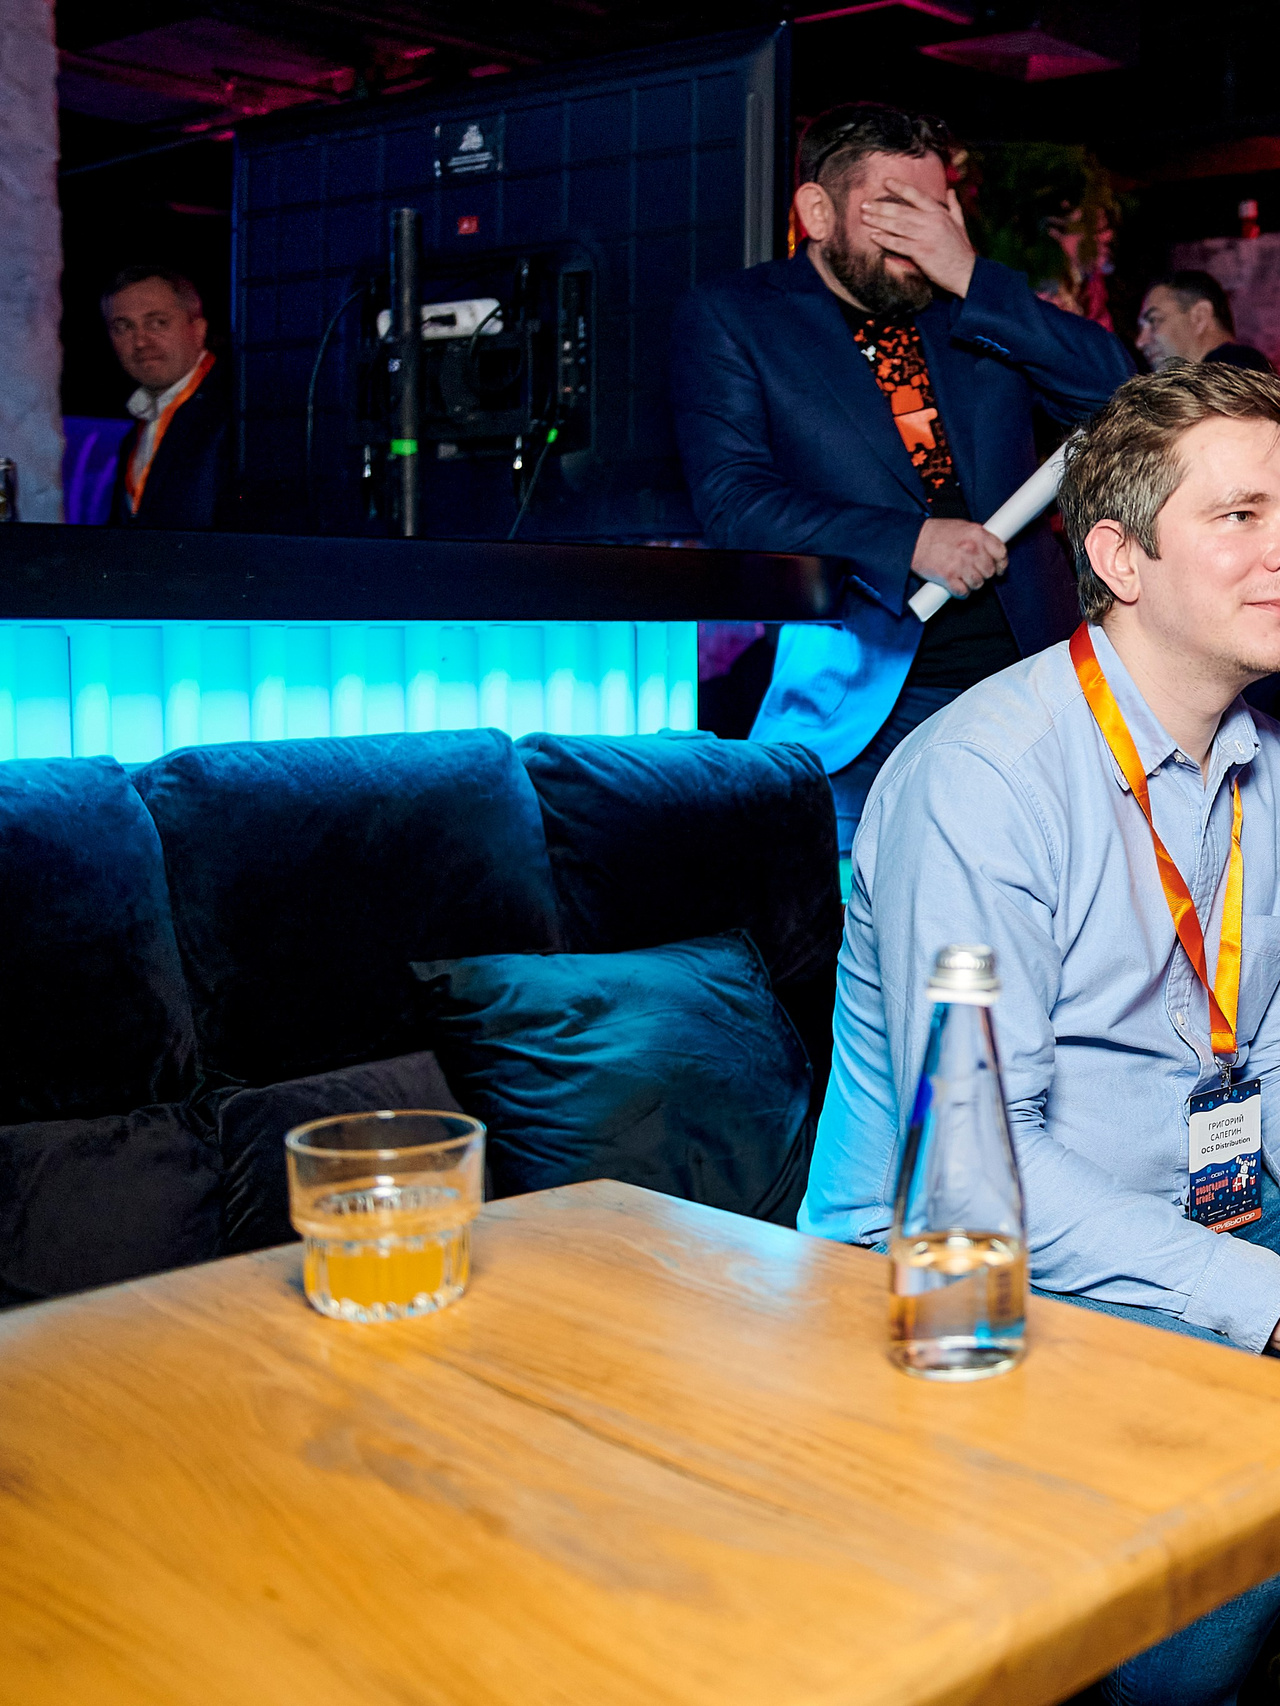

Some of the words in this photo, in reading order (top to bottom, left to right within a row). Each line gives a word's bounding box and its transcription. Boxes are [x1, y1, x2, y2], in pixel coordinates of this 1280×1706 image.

[1208, 1114, 1244, 1131] ГРИГОРИЙ
[1210, 1128, 1242, 1141] САПЕГИН
[1201, 1145, 1214, 1154] OCS
[1215, 1137, 1251, 1151] Distribution
